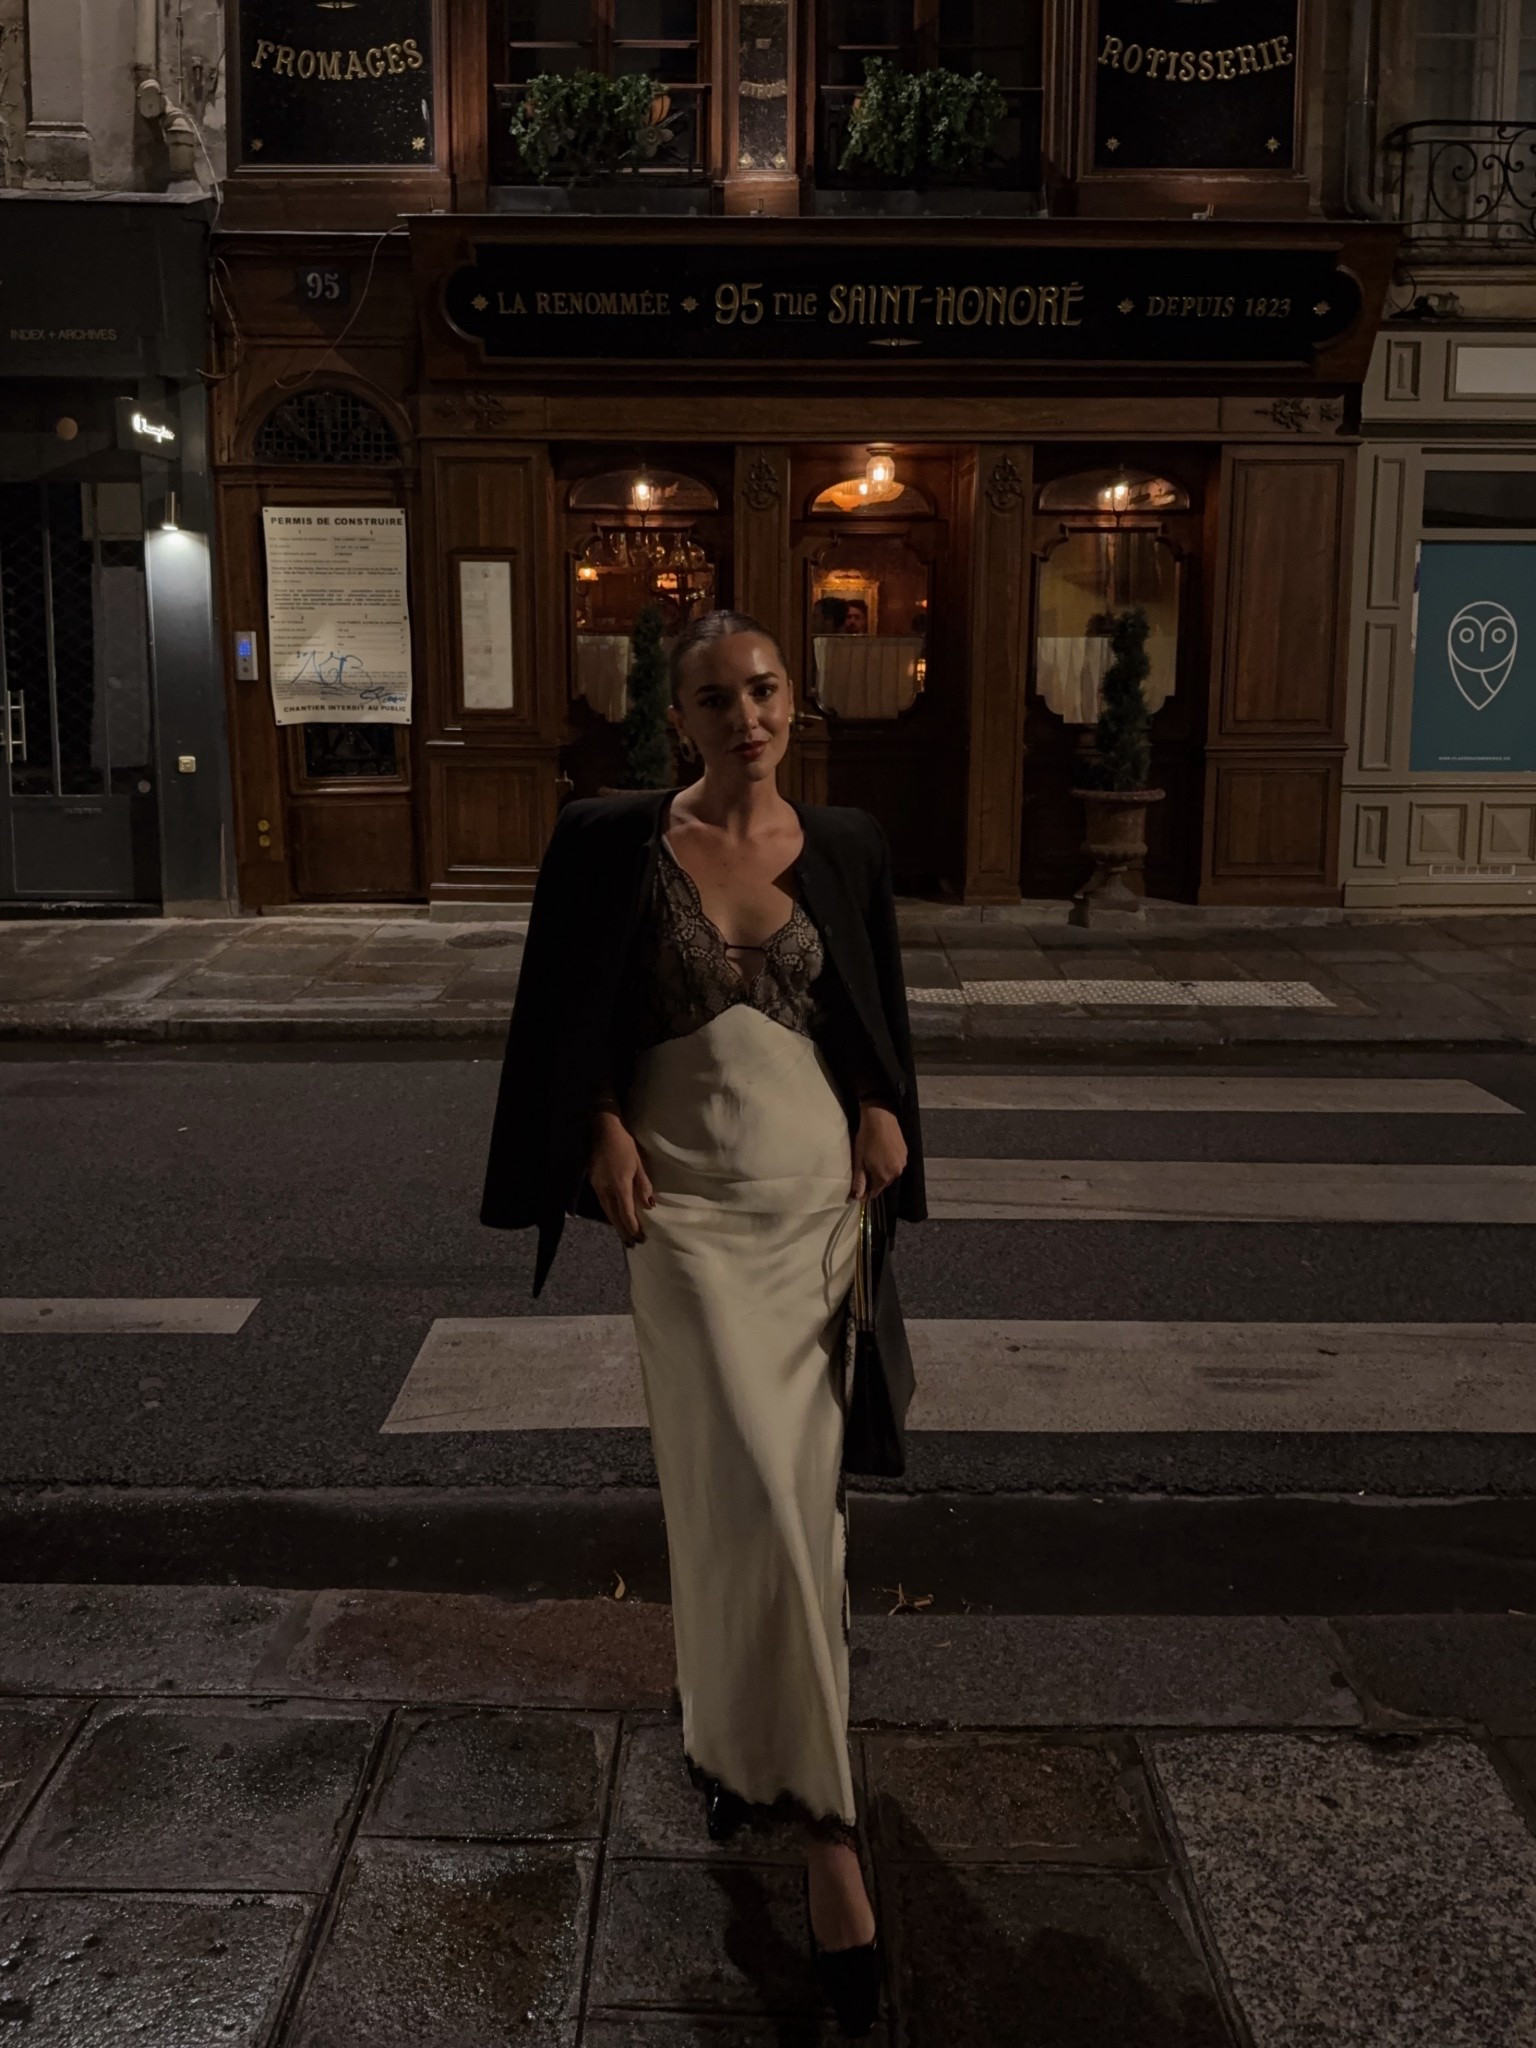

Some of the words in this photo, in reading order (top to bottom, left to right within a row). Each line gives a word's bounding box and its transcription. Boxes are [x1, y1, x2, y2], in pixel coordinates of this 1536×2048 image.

[251, 38, 424, 81] FROMAGES
[1097, 34, 1294, 83] ROTISSERIE
[306, 272, 341, 300] 95
[497, 291, 528, 315] LA
[535, 288, 672, 316] RENOMMÉE
[714, 281, 765, 325] 95
[772, 289, 818, 316] rue
[827, 281, 1085, 327] SAINT-HONORÉ
[1145, 296, 1236, 318] DEPUIS
[1245, 297, 1292, 319] 1823
[10, 328, 46, 341] INDEX
[58, 328, 118, 341] ARCHIVES
[270, 517, 313, 526] PERMIS
[316, 517, 331, 526] DE
[334, 517, 403, 527] CONSTRUIRE
[283, 704, 326, 713] CHANTIER
[328, 704, 365, 712] INTERDIT
[381, 705, 407, 713] PUBLIC
